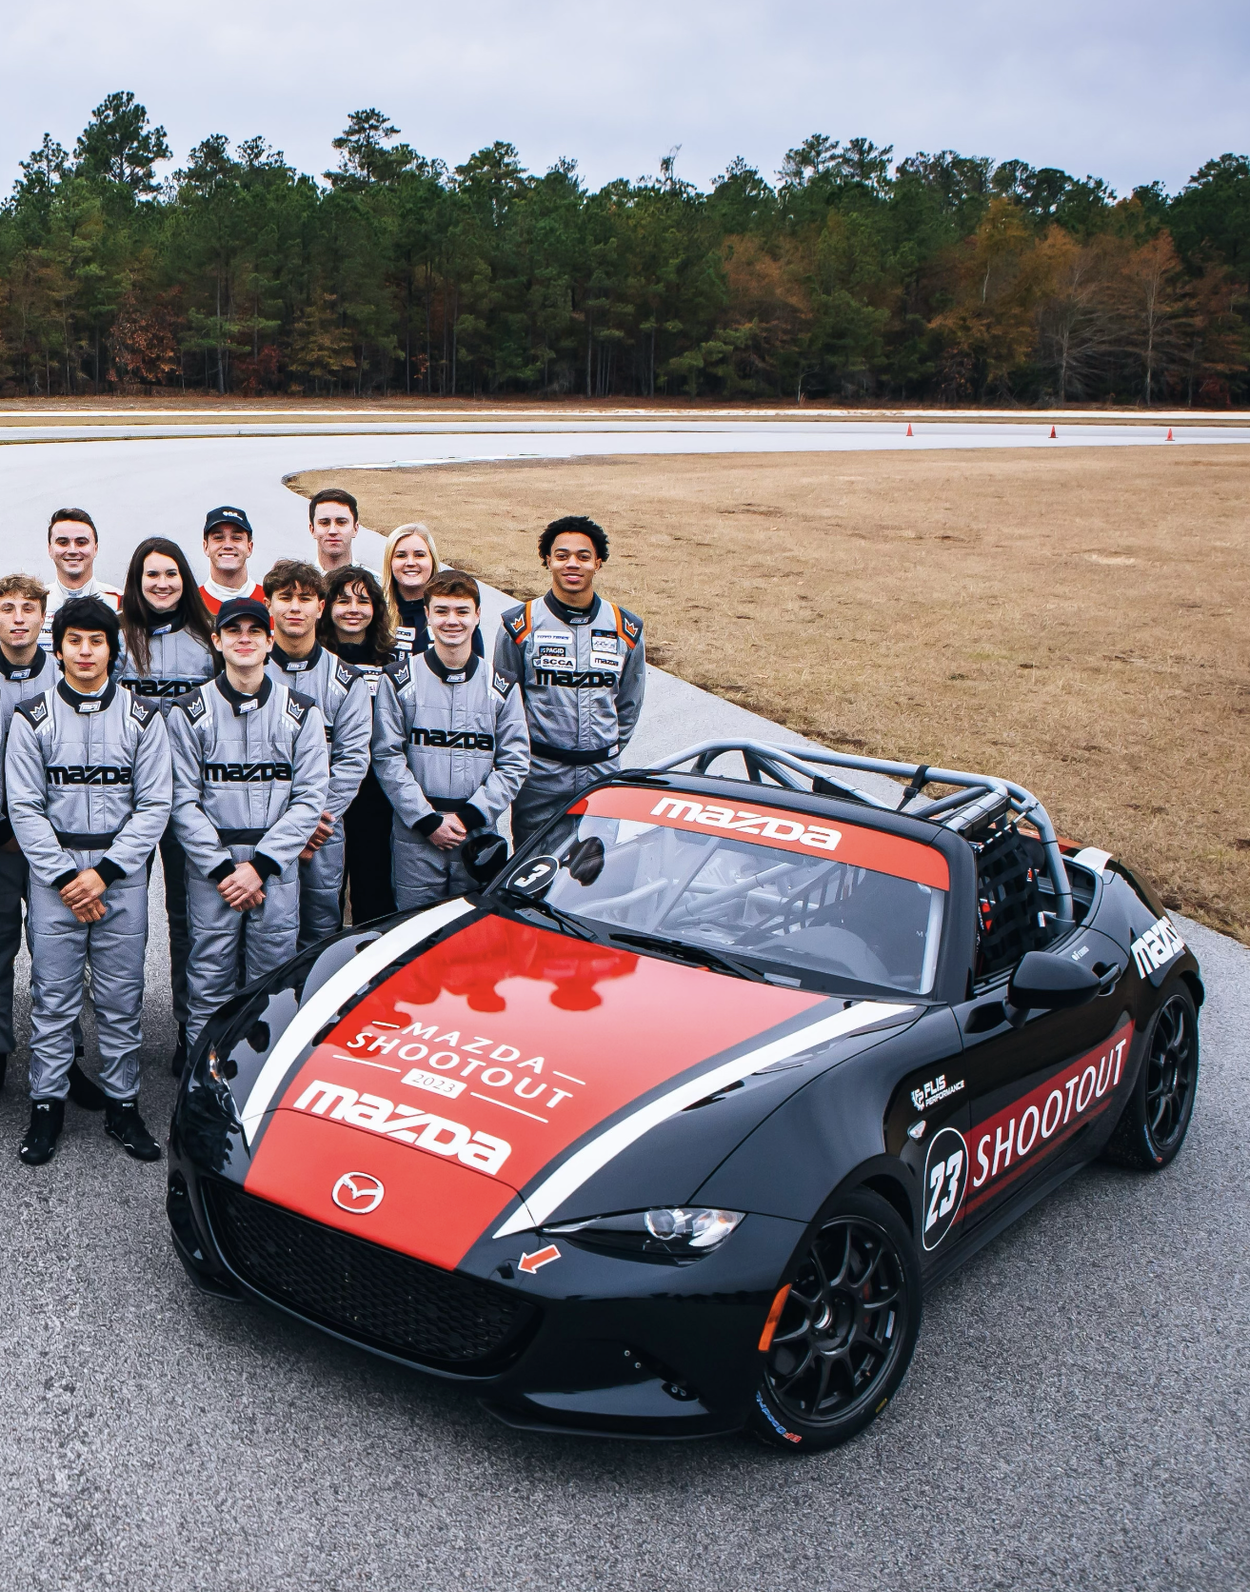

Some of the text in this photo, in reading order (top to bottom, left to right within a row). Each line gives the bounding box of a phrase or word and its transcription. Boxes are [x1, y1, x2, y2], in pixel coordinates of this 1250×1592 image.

[536, 669, 617, 688] mazda
[411, 728, 494, 751] mazda
[47, 765, 132, 785] mazda
[204, 762, 292, 782] mazda
[650, 797, 842, 852] mazda
[401, 1022, 545, 1074] MAZDA
[346, 1032, 574, 1108] SHOOTOUT
[412, 1072, 455, 1093] 2023
[924, 1074, 947, 1098] FLIS
[925, 1080, 964, 1108] PERFORMANCE
[973, 1038, 1127, 1188] SHOOTOUT
[293, 1079, 512, 1176] mazda
[924, 1149, 964, 1233] 23
